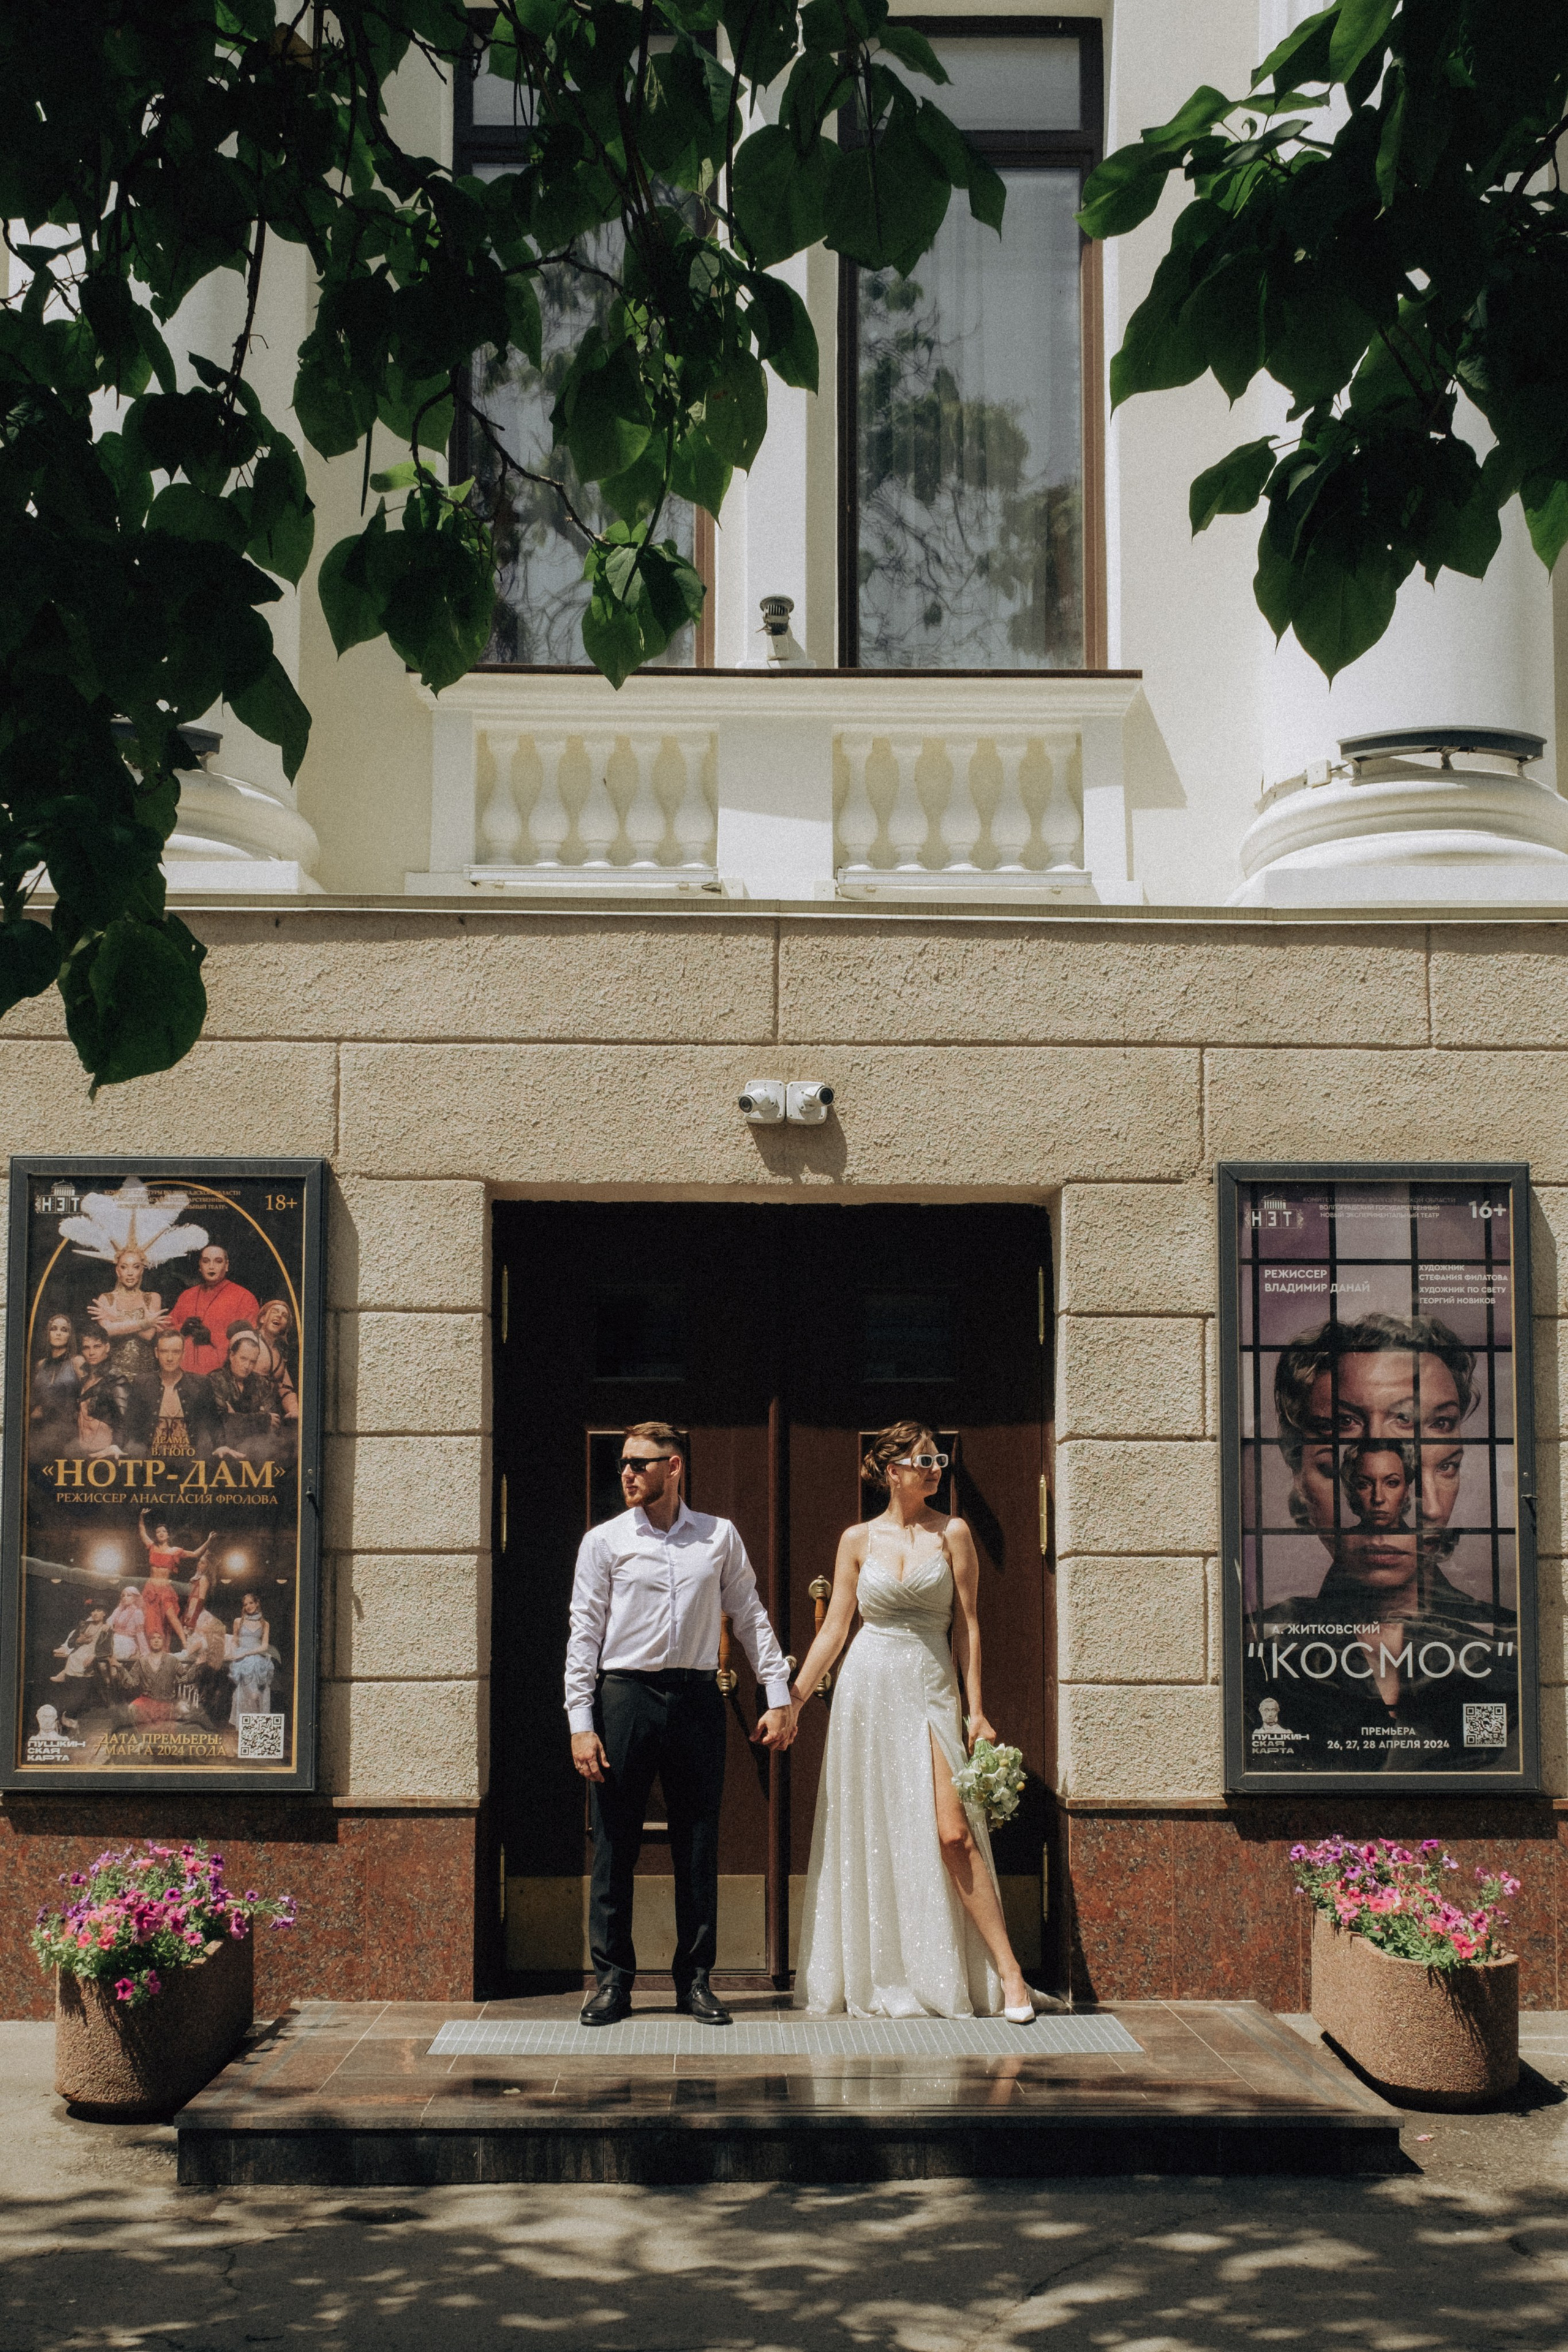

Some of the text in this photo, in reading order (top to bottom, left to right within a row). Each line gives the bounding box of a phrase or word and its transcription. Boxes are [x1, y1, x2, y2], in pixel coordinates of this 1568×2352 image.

[265, 1194, 298, 1211] 18+
[1468, 1200, 1507, 1218] 16+
[1251, 1211, 1292, 1227] НЭТ
[1264, 1269, 1327, 1278] РЕЖИССЕР
[1265, 1281, 1370, 1294] ВЛАДИМИР ДАНАЙ
[152, 1436, 190, 1444] ДРАМА
[151, 1447, 195, 1457] В. ГЮГО
[42, 1459, 286, 1494] «НОТР-ДАМ»
[56, 1492, 278, 1505] РЕЖИССЕР АНАСТАСИЯ ФРОЛОВА
[1272, 1621, 1381, 1635] А. ЖИТКОВСКИЙ
[1248, 1642, 1513, 1679] "КОСМОС"
[1361, 1727, 1416, 1736] ПРЕМЬЕРА
[100, 1733, 222, 1745] ДАТА ПРЕМЬЕРЫ:
[1327, 1740, 1450, 1751] 26, 27, 28 АПРЕЛЯ 2024
[94, 1745, 227, 1757] 7 МАРТА 2024 ГОДА
